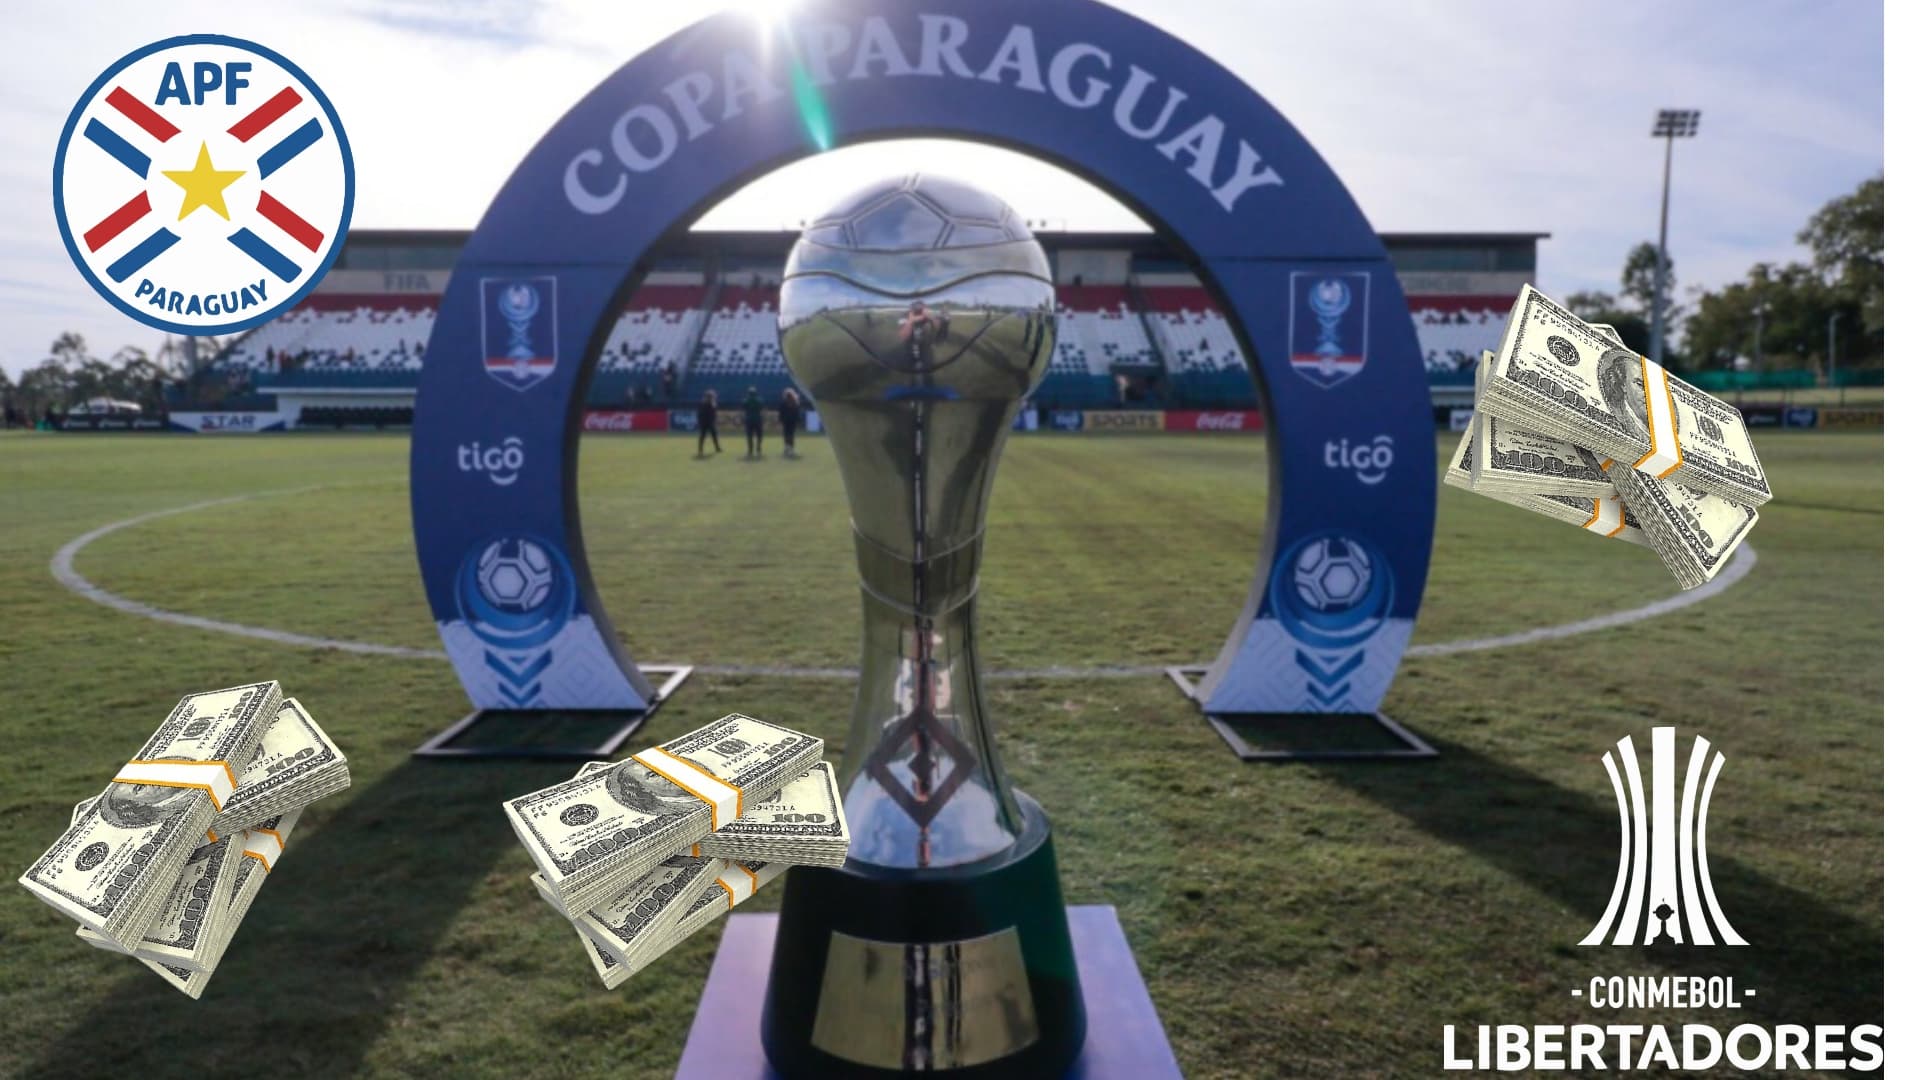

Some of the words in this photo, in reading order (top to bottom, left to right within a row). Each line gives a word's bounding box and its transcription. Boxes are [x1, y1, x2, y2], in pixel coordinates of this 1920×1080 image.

[563, 48, 785, 215] COPA
[806, 13, 1284, 213] PARAGUAY
[458, 436, 523, 485] tigo
[1325, 435, 1393, 484] tigo
